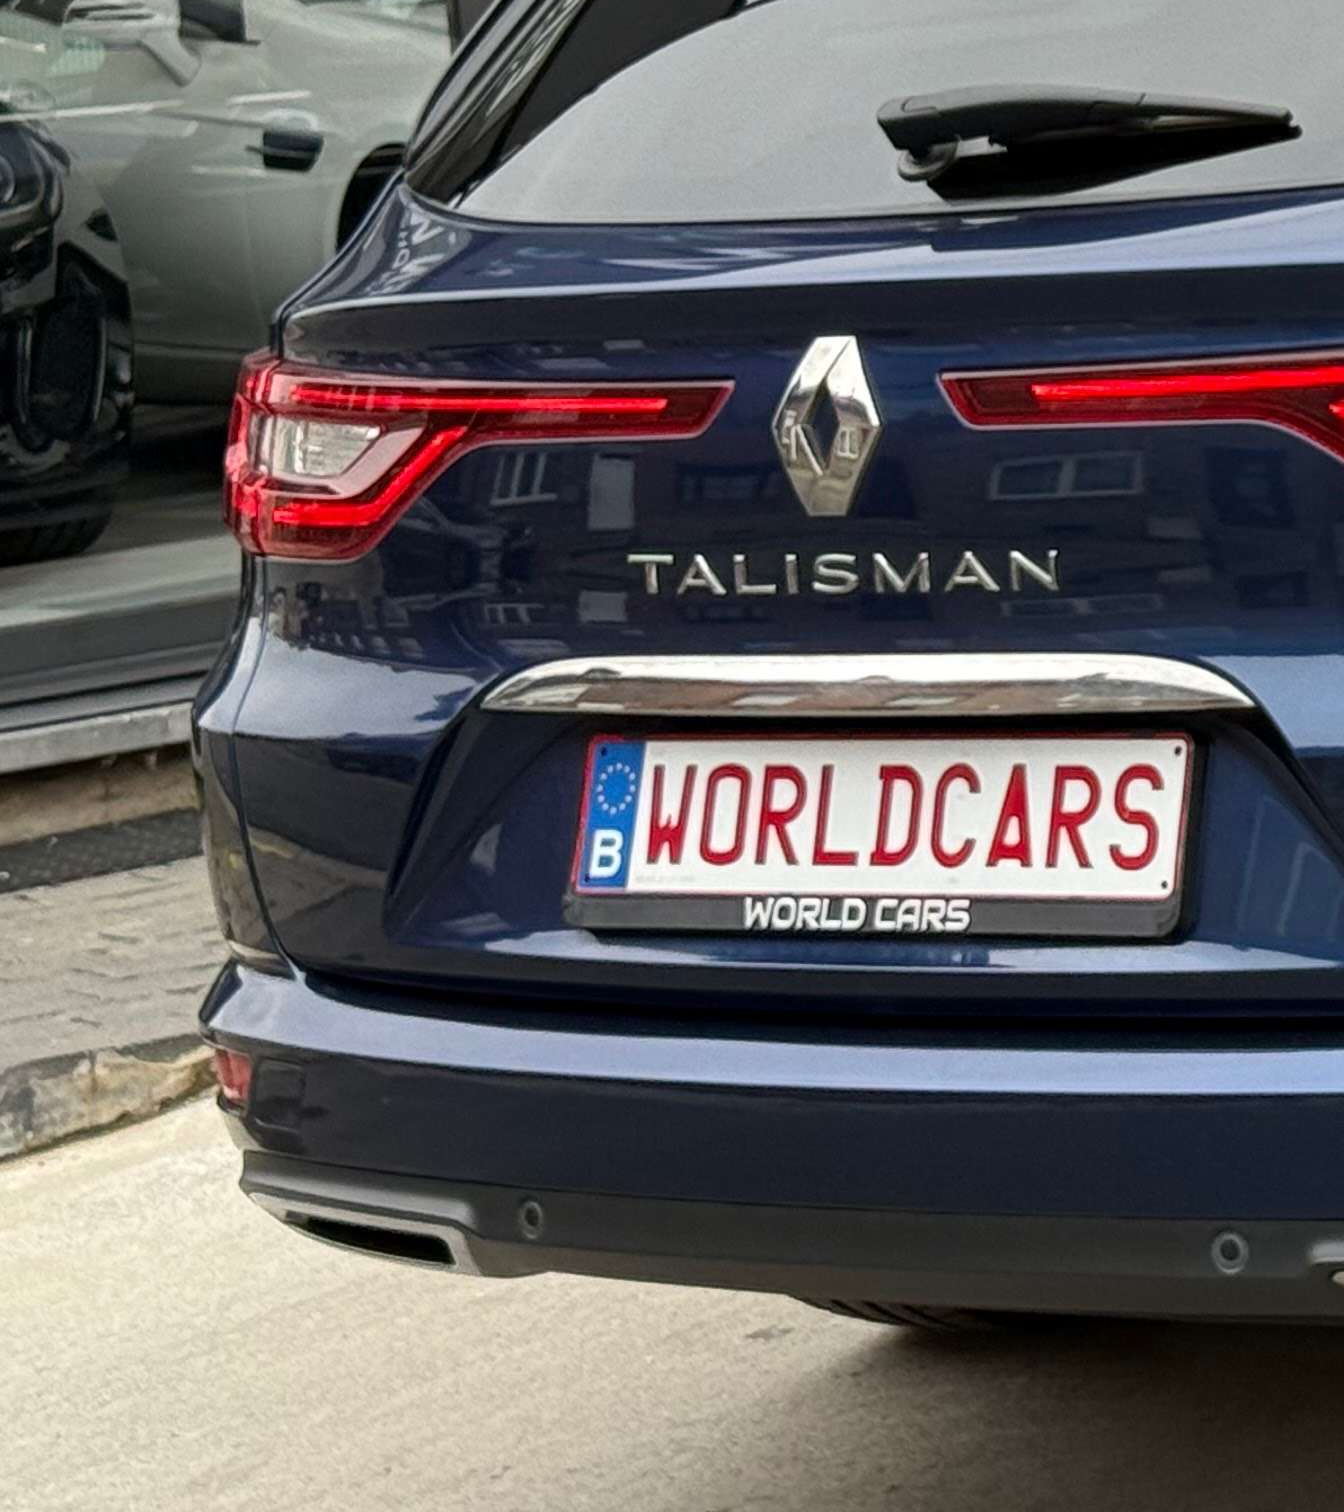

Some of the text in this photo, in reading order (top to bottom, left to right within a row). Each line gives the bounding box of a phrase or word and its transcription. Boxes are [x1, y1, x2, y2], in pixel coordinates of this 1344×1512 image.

[626, 549, 1060, 595] TALISMAN
[589, 763, 1165, 877] B WORLDCARS
[743, 896, 972, 933] WORLD CARS
